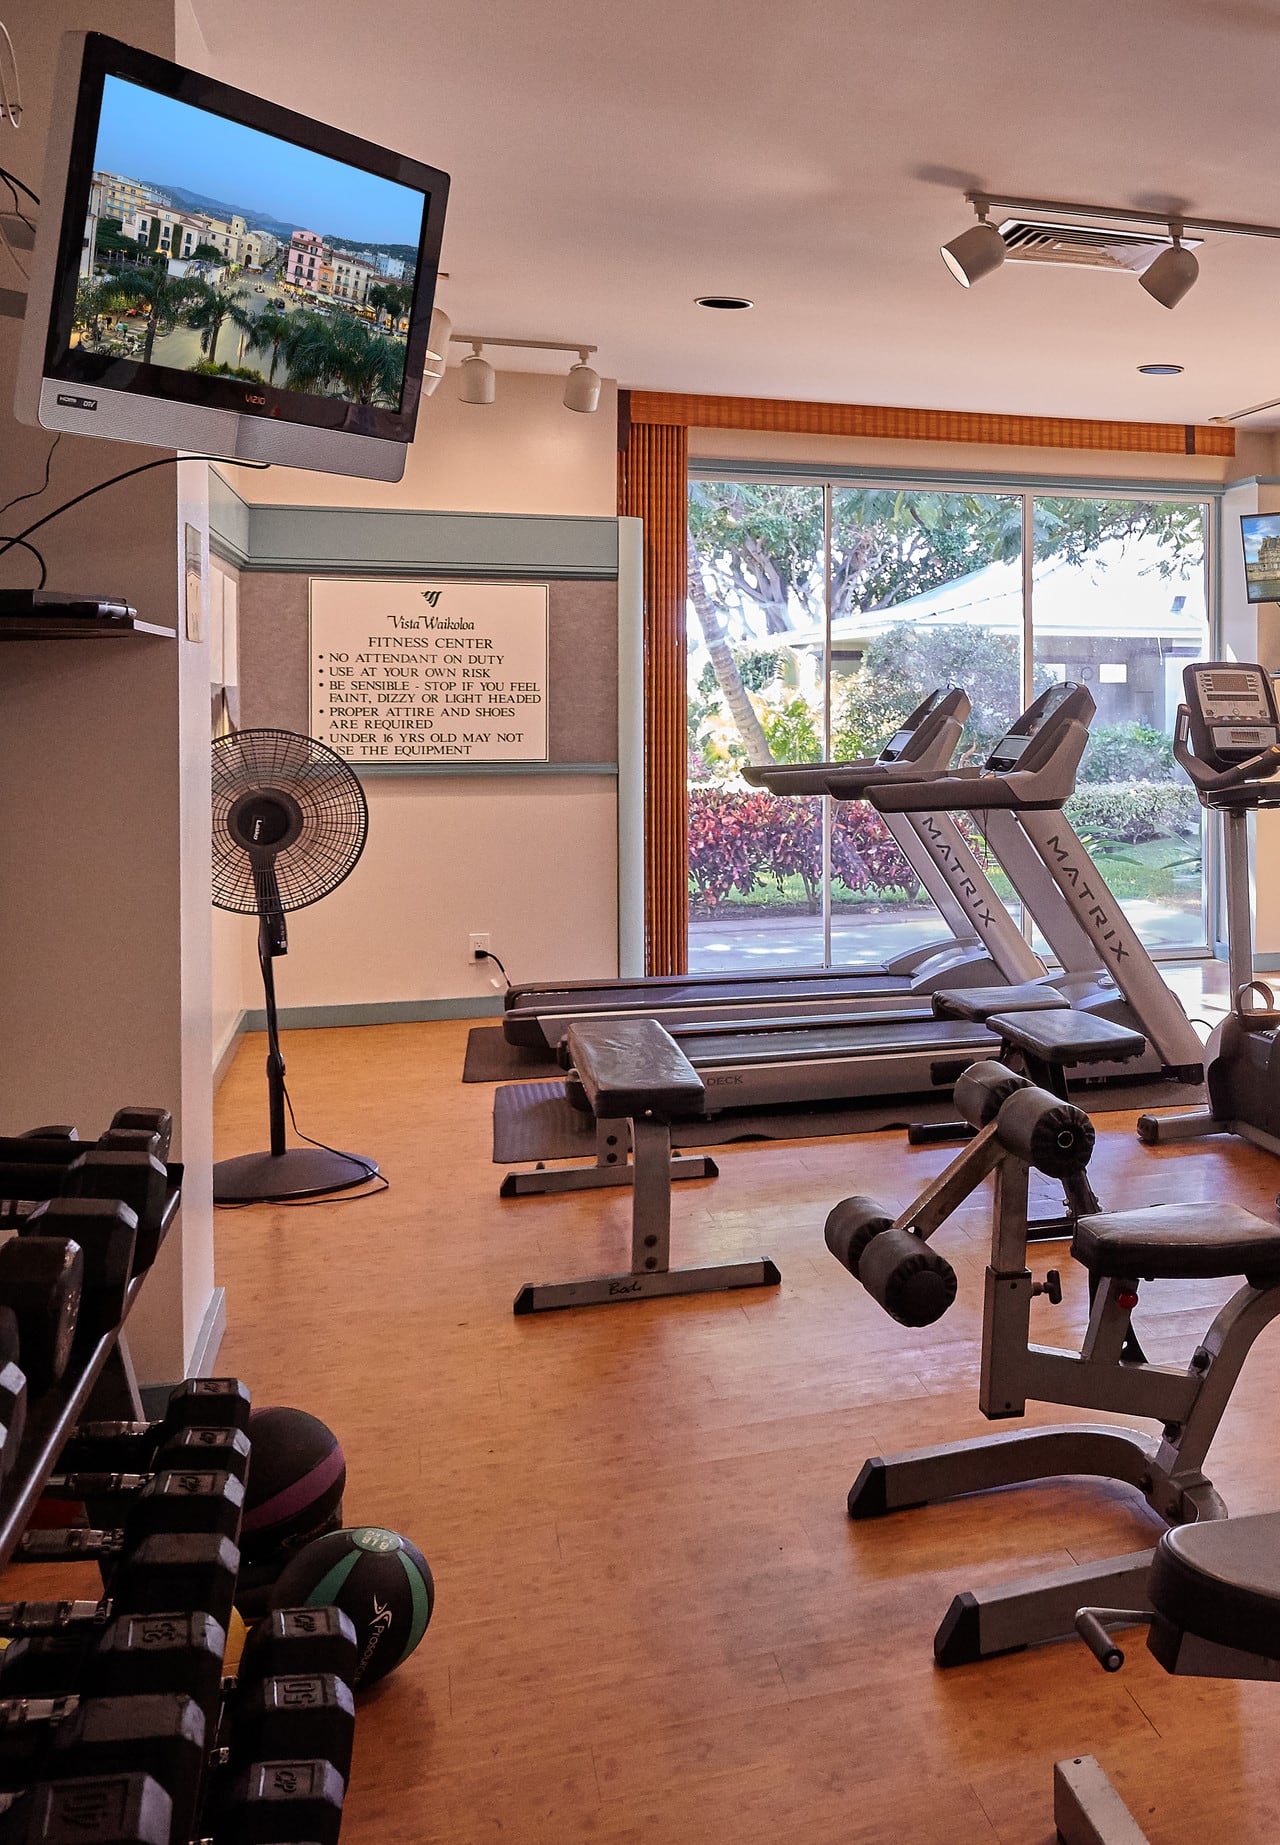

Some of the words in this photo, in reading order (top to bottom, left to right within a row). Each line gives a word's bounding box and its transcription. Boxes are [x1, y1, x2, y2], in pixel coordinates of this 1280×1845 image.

[387, 615, 419, 629] Vista
[419, 615, 475, 630] Waikoloa
[368, 637, 428, 648] FITNESS
[434, 638, 493, 649] CENTER
[329, 653, 349, 662] NO
[355, 653, 438, 663] ATTENDANT
[443, 654, 463, 664] ON
[468, 655, 504, 664] DUTY
[329, 667, 354, 676] USE
[360, 667, 377, 676] AT
[384, 667, 419, 677] YOUR
[425, 668, 456, 677] OWN
[462, 668, 491, 677] RISK
[329, 681, 345, 690] BE
[351, 681, 410, 690] SENSIBLE
[425, 682, 457, 691] STOP
[462, 682, 474, 691] IF
[480, 682, 505, 691] YOU
[510, 682, 540, 692] FEEL
[329, 693, 372, 704] FAINT,
[377, 693, 416, 703] DIZZY
[422, 694, 439, 703] OR
[445, 694, 483, 704] LIGHT
[488, 694, 542, 704] HEADED
[329, 707, 379, 717] PROPER
[386, 707, 435, 717] ATTIRE
[440, 707, 471, 717] AND
[475, 707, 516, 717] SHOES
[329, 719, 359, 729] ARE
[364, 719, 433, 731] REQUIRED
[329, 733, 377, 743] UNDER
[383, 733, 394, 743] 16
[400, 733, 425, 743] YRS
[430, 733, 457, 743] OLD
[462, 733, 491, 743] MAY
[497, 733, 524, 743] NOT
[361, 745, 389, 755] THE
[394, 745, 472, 757] EQUIPMENT
[922, 817, 996, 928] MATRIX
[1046, 836, 1129, 963] MATRIX
[706, 1075, 743, 1086] DECK
[361, 1535, 379, 1546] LB
